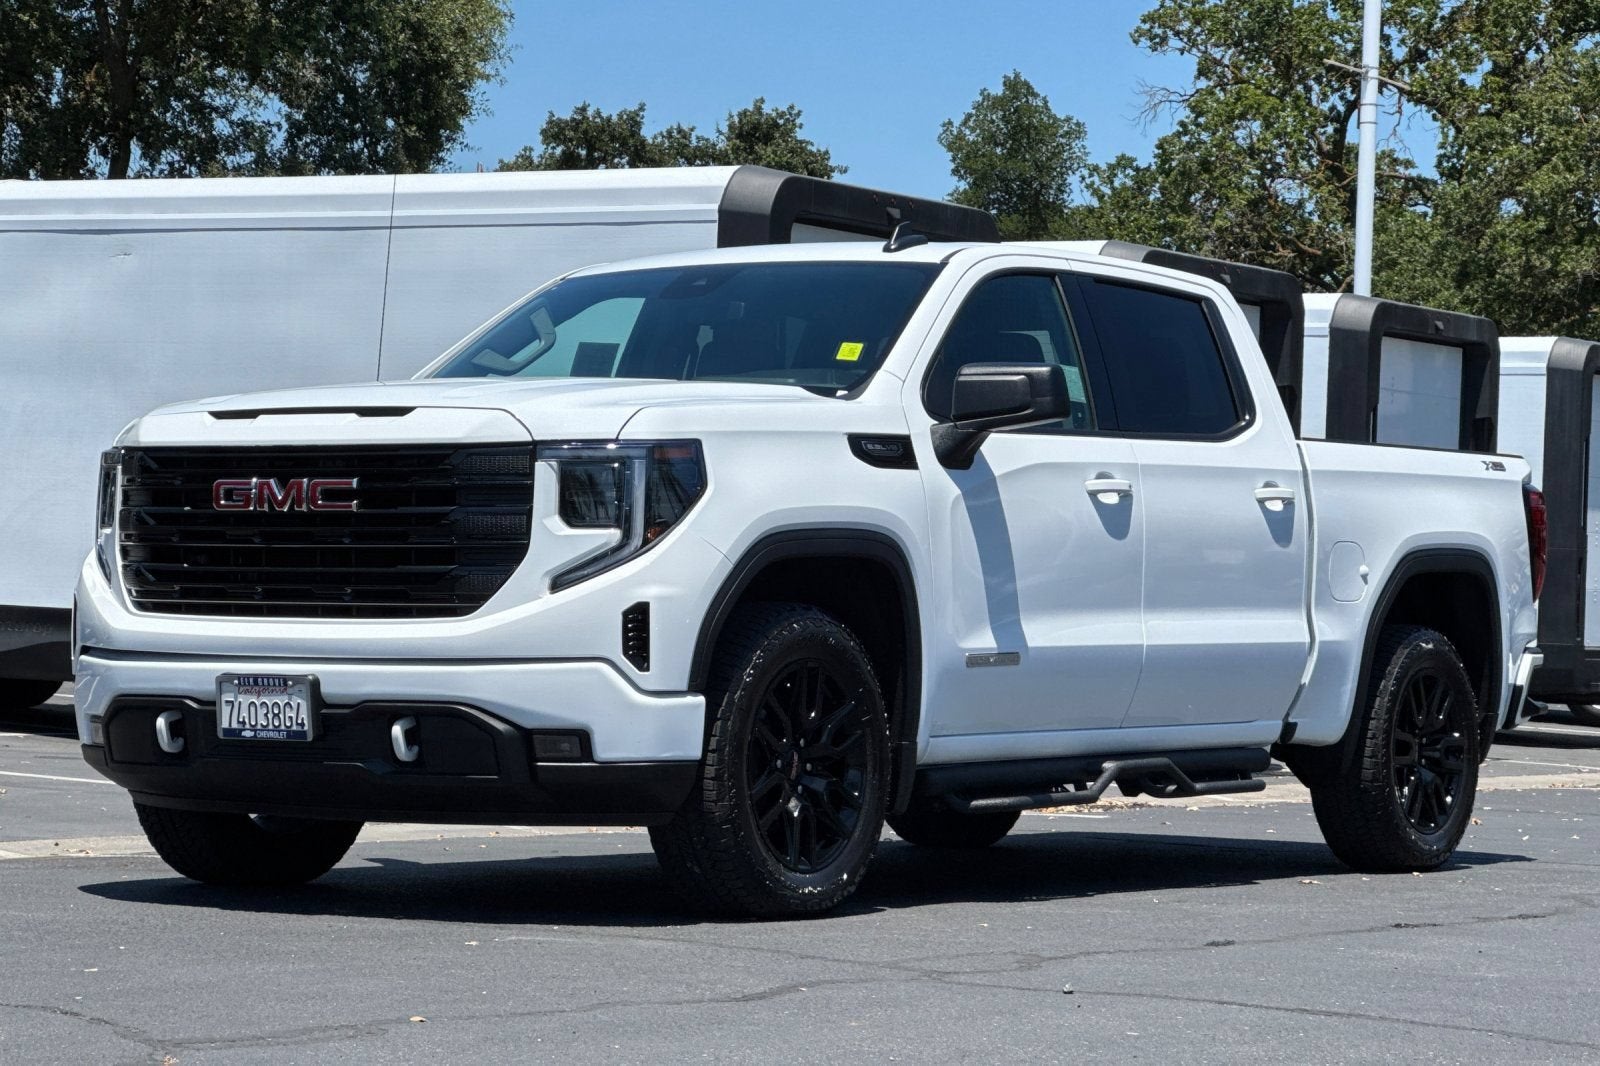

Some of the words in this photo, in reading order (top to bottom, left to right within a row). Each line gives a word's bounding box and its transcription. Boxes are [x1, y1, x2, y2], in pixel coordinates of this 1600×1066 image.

[213, 477, 359, 512] GMC
[240, 677, 254, 685] ELK
[257, 678, 284, 686] GROVE
[237, 686, 289, 699] California
[224, 699, 306, 729] 74038G4
[256, 731, 287, 739] CHEVROLET
